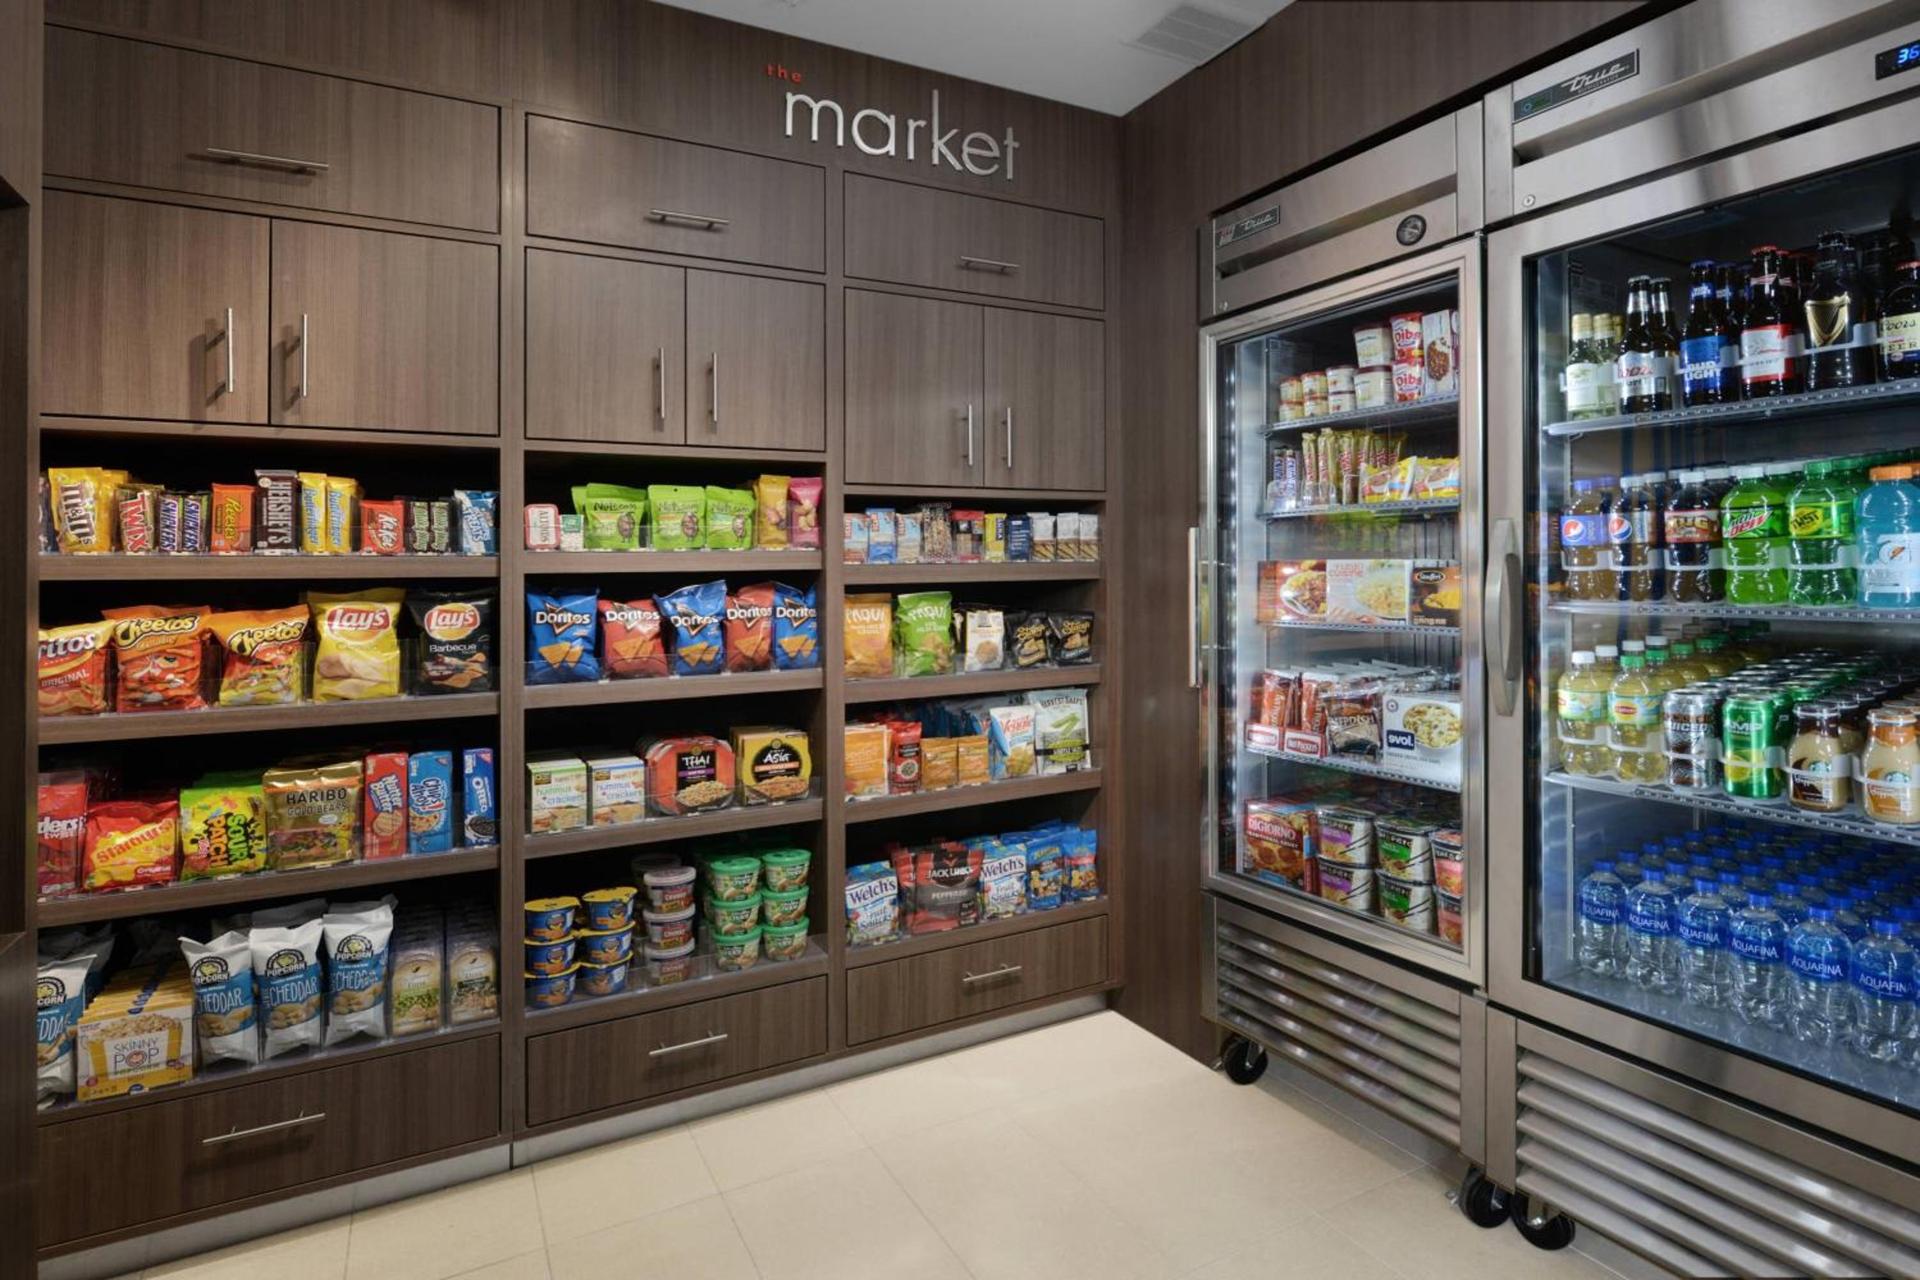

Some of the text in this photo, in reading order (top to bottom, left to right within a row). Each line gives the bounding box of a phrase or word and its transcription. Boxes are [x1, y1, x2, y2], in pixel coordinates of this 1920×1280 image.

[767, 63, 802, 84] the
[1561, 63, 1625, 92] True
[785, 88, 1020, 181] market
[1395, 328, 1422, 343] Dibs
[1396, 373, 1422, 386] Dibs
[1685, 368, 1722, 380] LIGHT
[119, 491, 149, 552] TWIX
[160, 496, 178, 553] SNICKERS
[182, 496, 200, 552] SNICKERS
[329, 606, 387, 631] Lay's
[430, 608, 474, 631] Lay's
[535, 611, 591, 625] Doritos
[605, 610, 660, 622] Doritos
[670, 614, 719, 628] Doritos
[726, 606, 773, 620] Doritos
[115, 614, 201, 648] Cheetos
[228, 620, 305, 658] Cheetos
[37, 630, 97, 660] ritos
[429, 643, 477, 654] Barbecue
[682, 755, 710, 767] THAI
[286, 787, 348, 805] HARIBO
[371, 780, 393, 813] Butter
[382, 774, 403, 809] Nutter
[471, 776, 488, 813] OREO
[208, 815, 228, 867] PATCH
[226, 814, 248, 861] SOUR
[927, 869, 949, 879] JACK
[981, 857, 1025, 878] Welch's
[848, 878, 897, 905] Welch's
[1629, 912, 1671, 931] AQUAFINA
[1679, 924, 1721, 944] AQUAFINA
[1732, 936, 1780, 959] AQUAFINA
[266, 961, 307, 978] POPCORN
[1791, 954, 1844, 977] AQUAFINA
[268, 976, 318, 1007] CHEDDAR
[1858, 973, 1914, 993] AQUAFINA
[199, 987, 244, 1014] HEDDAR
[113, 1037, 159, 1054] SKINNY
[114, 1047, 160, 1069] POP
